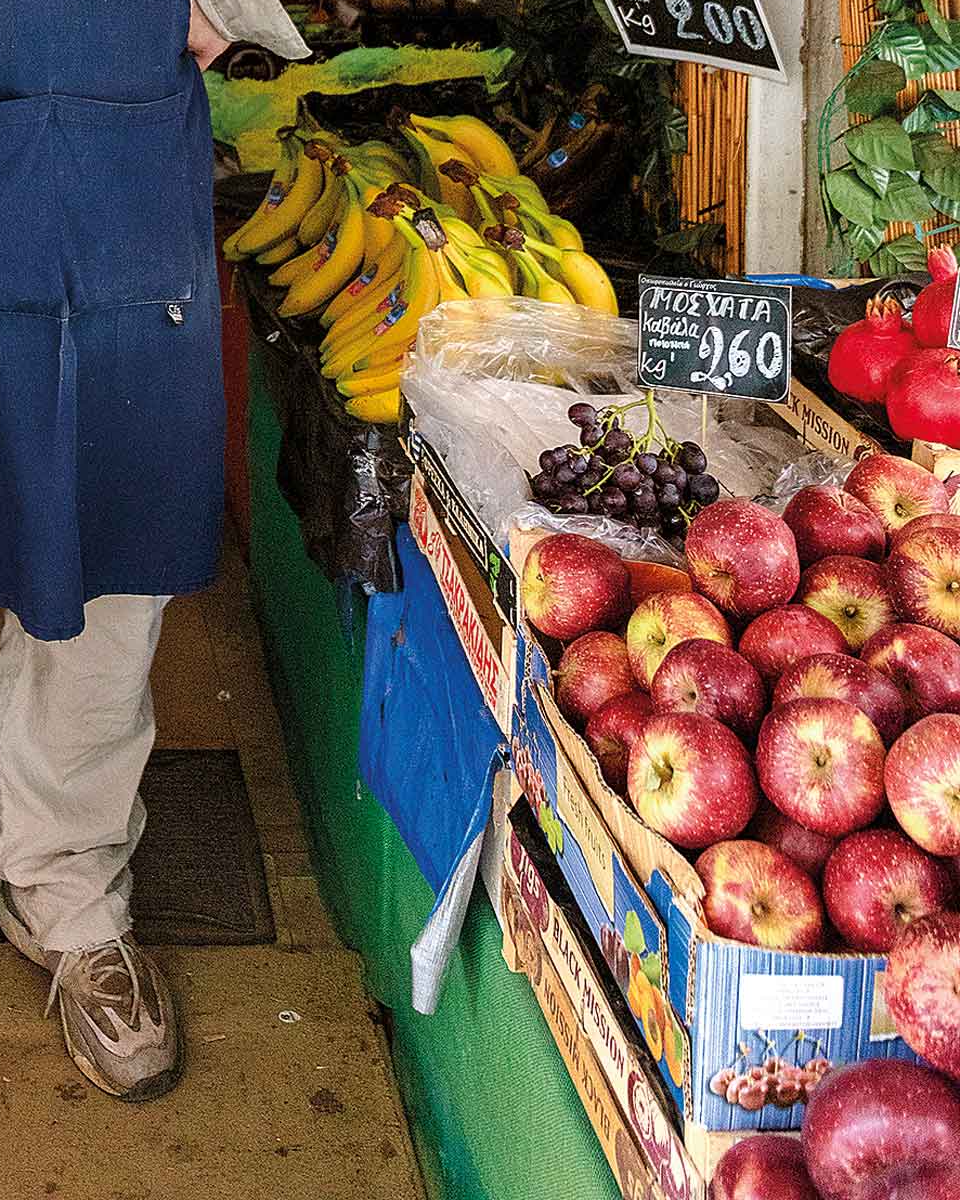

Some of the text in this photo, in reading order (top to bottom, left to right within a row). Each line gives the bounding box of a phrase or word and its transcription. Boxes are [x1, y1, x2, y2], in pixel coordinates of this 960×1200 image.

[649, 286, 772, 324] ΜΟΣΧΑΤΑ
[802, 404, 851, 456] MISSION
[552, 916, 626, 1079] BLACK MISSION
